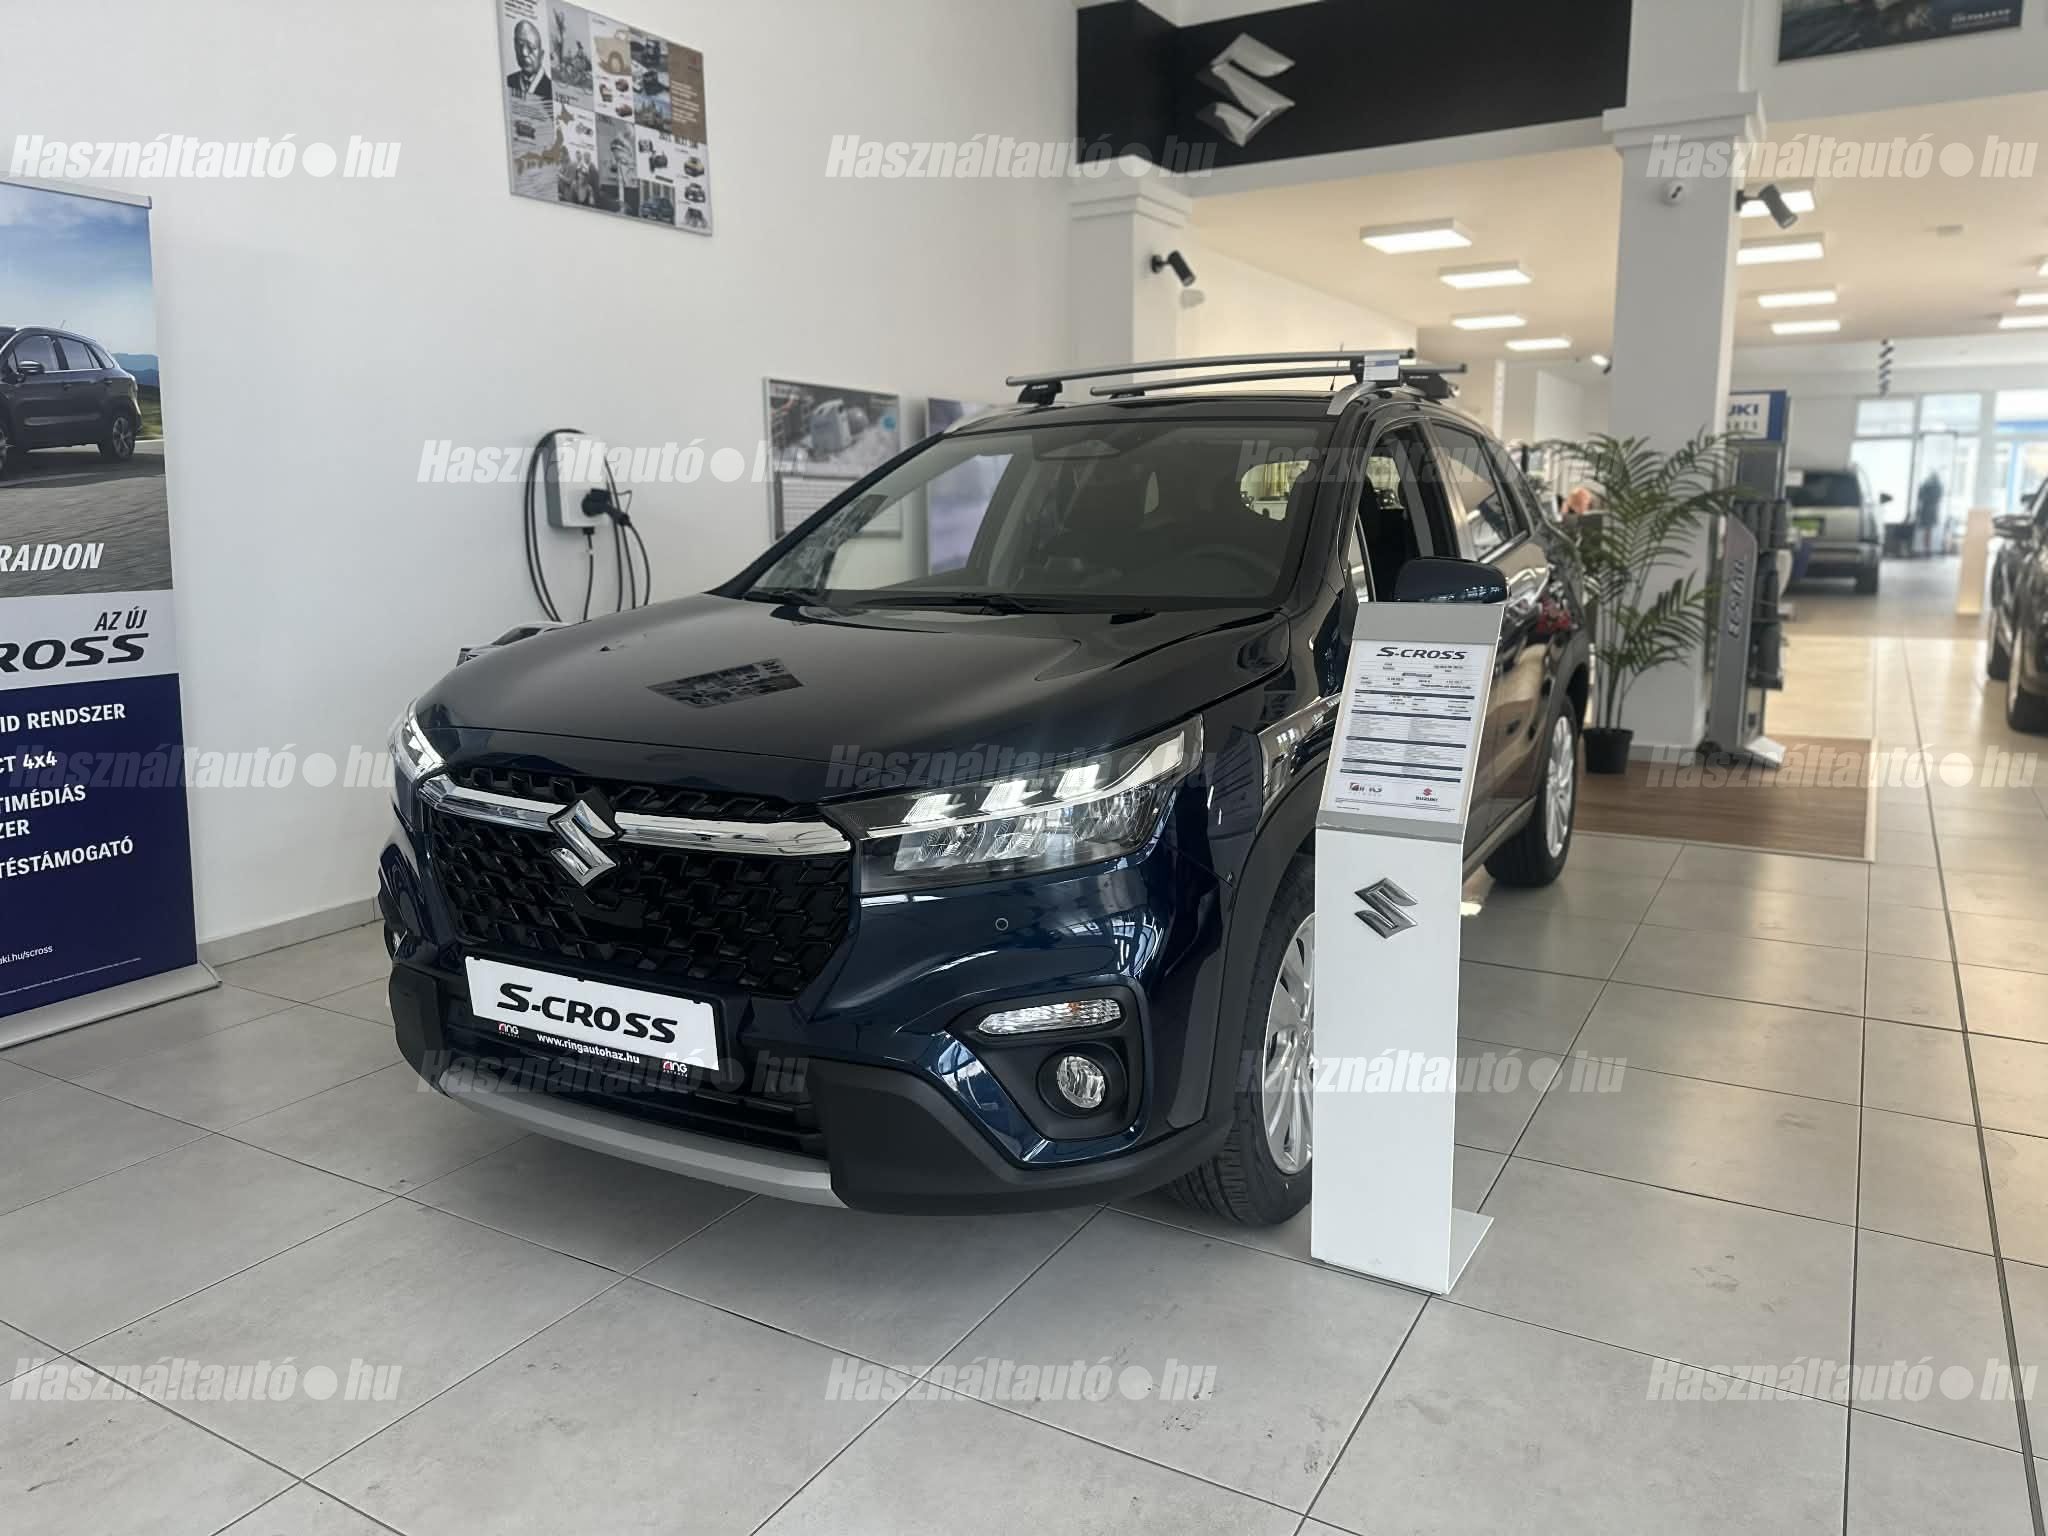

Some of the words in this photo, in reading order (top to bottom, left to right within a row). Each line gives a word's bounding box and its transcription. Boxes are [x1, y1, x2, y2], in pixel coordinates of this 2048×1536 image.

[0, 543, 104, 572] RAIDON
[94, 611, 122, 631] AZ
[125, 606, 147, 629] ÚJ
[27, 703, 126, 730] RENDSZER
[23, 750, 57, 769] 4x4
[0, 784, 86, 814] IMÉDIÁS
[496, 982, 678, 1044] S-CROSS
[536, 1033, 640, 1065] www.ringautohaz.hu
